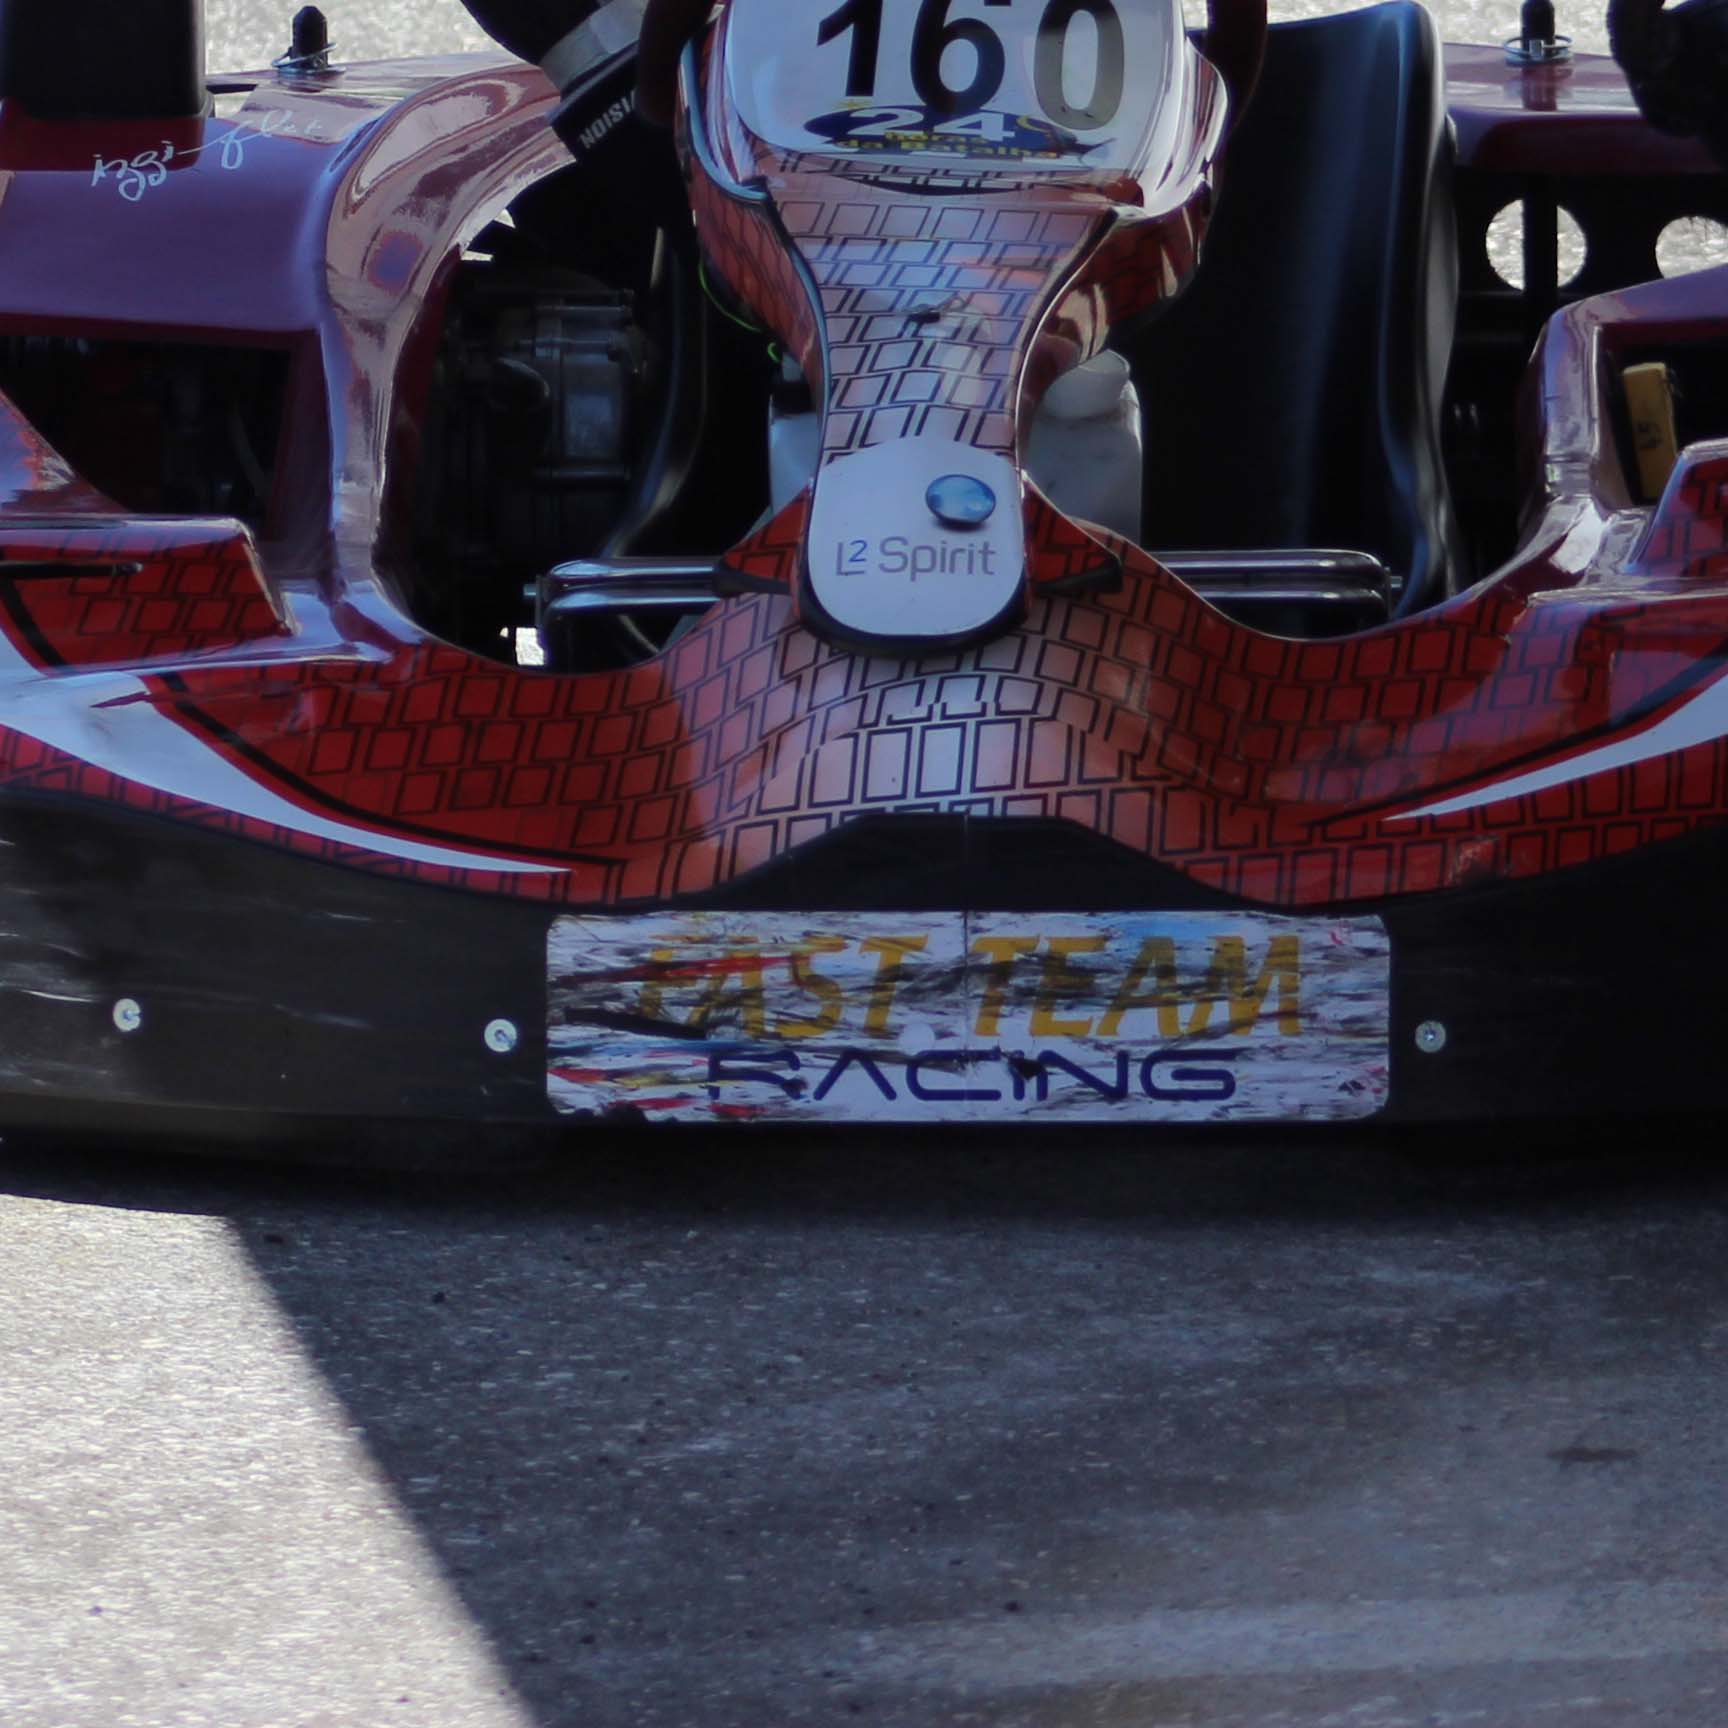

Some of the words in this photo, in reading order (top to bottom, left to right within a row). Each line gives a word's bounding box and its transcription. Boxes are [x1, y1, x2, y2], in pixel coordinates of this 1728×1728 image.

[847, 108, 1016, 141] 24
[878, 536, 997, 582] Spirit
[640, 936, 930, 1038] FAST
[969, 935, 1301, 1038] TEAM
[706, 1048, 1238, 1103] RACING
